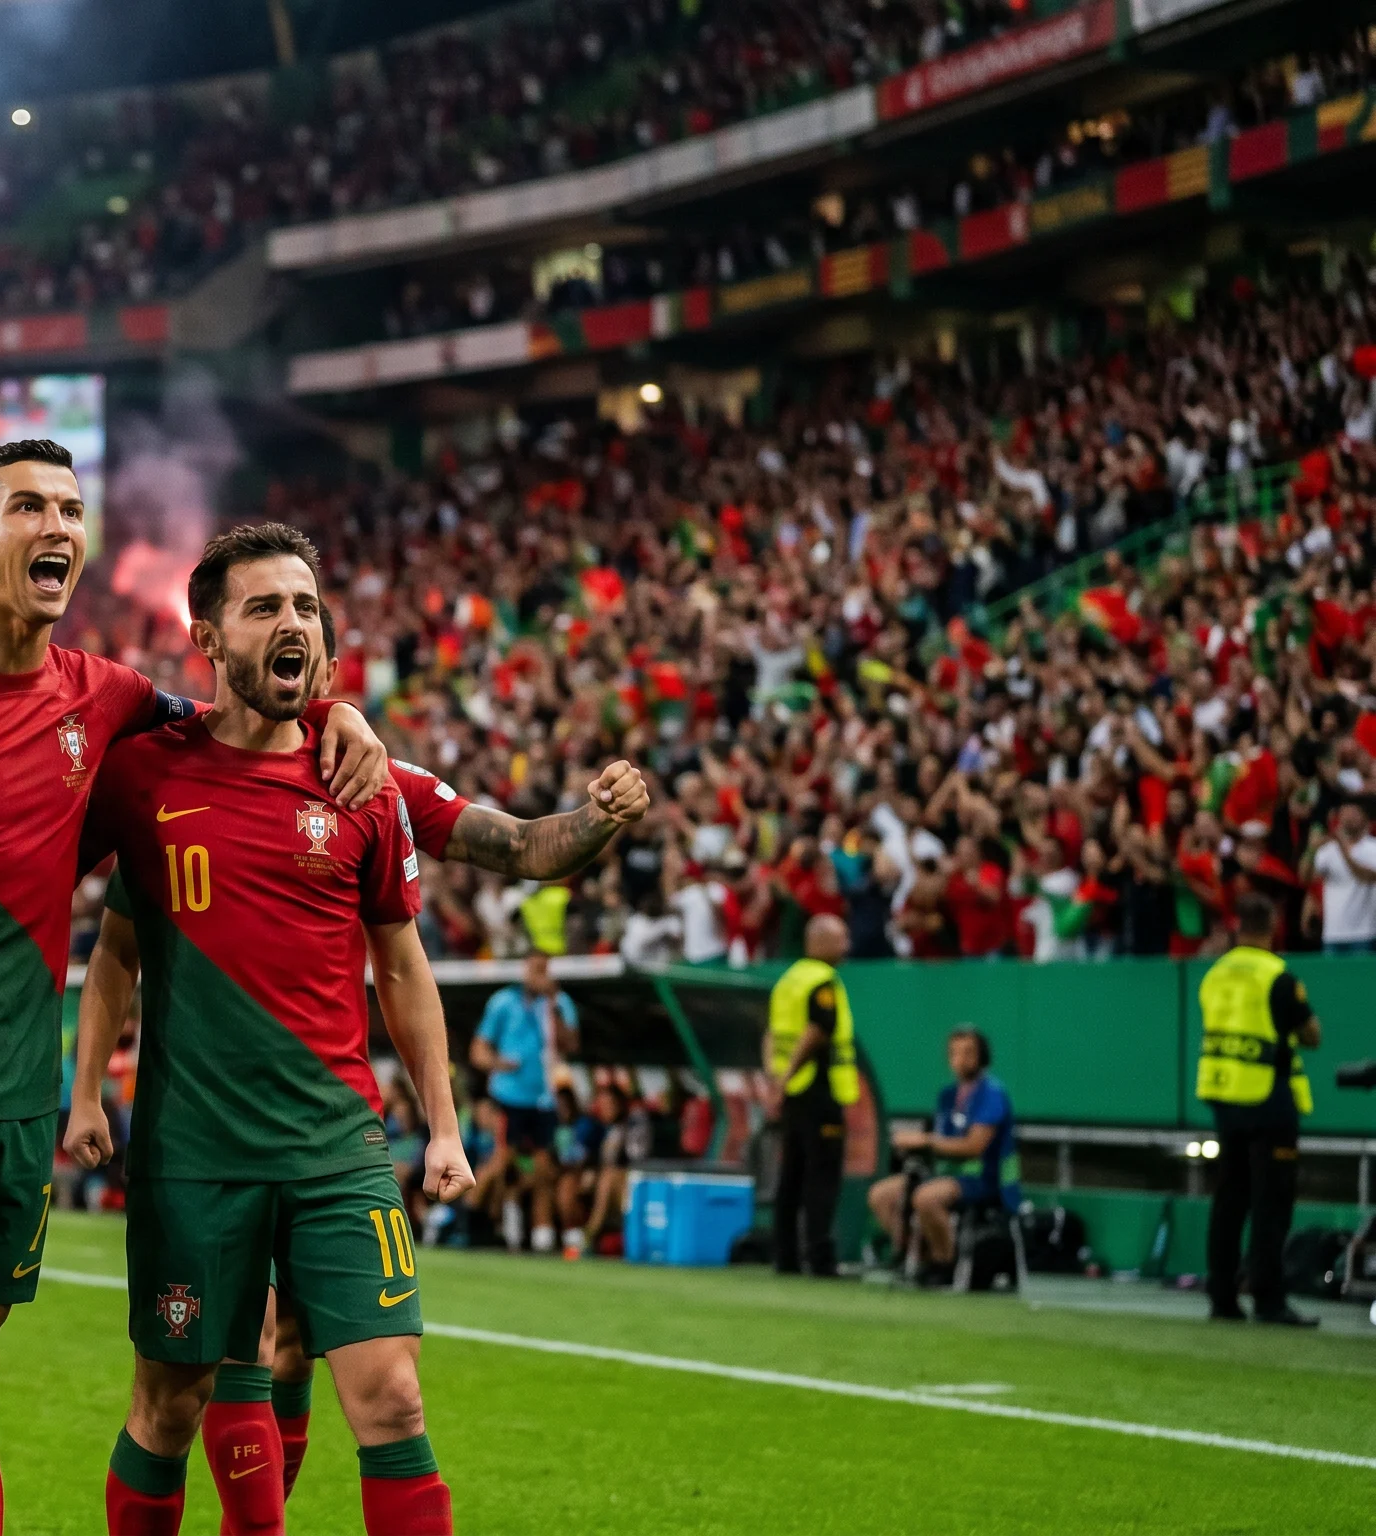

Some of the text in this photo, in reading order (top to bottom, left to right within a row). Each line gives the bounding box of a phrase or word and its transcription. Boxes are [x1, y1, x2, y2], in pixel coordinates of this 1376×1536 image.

[165, 844, 211, 912] 10
[29, 1183, 51, 1252] 7
[369, 1207, 415, 1278] 10
